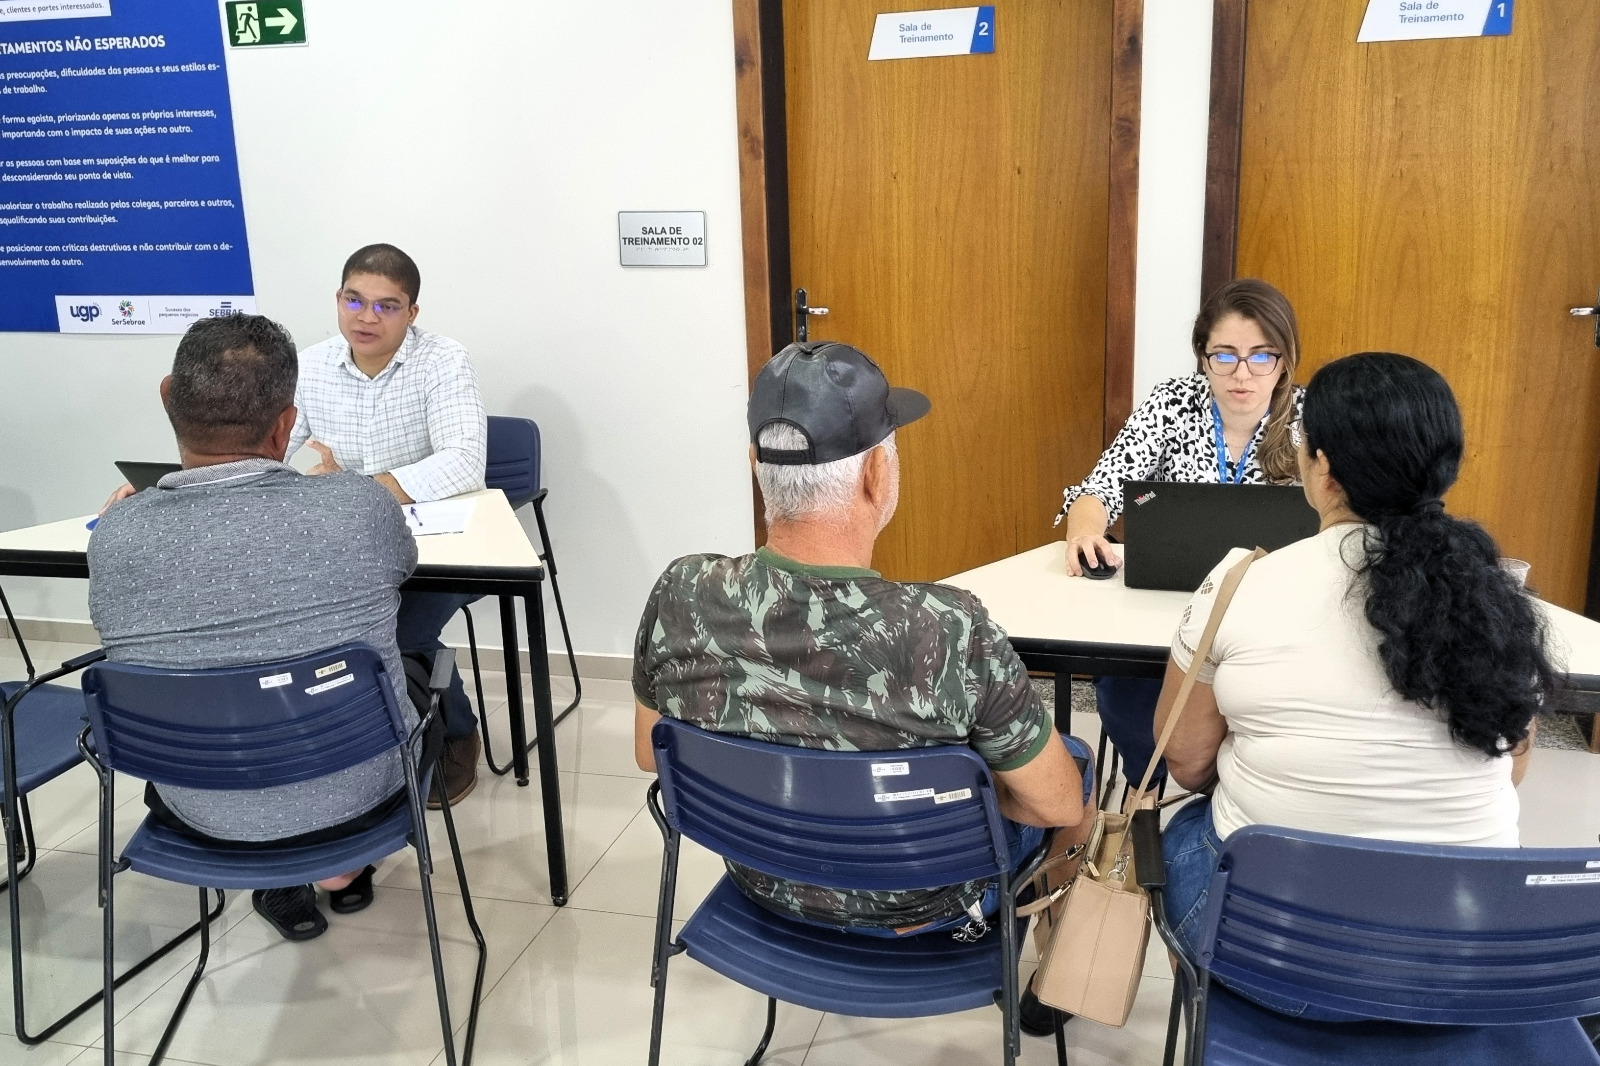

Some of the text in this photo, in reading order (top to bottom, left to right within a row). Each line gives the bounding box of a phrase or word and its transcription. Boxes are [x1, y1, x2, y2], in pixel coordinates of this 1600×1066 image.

[6, 6, 31, 14] clientes
[38, 5, 59, 13] partes
[60, 2, 105, 11] interessadas.
[1399, 0, 1439, 11] Sala de
[1497, 2, 1505, 18] 1
[1399, 13, 1464, 23] Treinamento
[899, 22, 932, 32] Sala de
[979, 21, 989, 36] 2
[65, 36, 91, 51] NÃO
[95, 35, 166, 50] ESPERADOS
[899, 33, 954, 43] Treinamento
[7, 69, 59, 81] preocupações,
[61, 67, 106, 77] dificuldades
[108, 66, 121, 75] das
[123, 66, 154, 76] pessoas
[162, 65, 179, 73] seus
[181, 62, 206, 72] estilos
[207, 63, 220, 71] es-
[3, 84, 48, 94] de trabalho.
[2, 115, 25, 124] forma
[57, 112, 101, 123] priorizando
[102, 113, 130, 122] apenas
[142, 109, 174, 121] próprios
[175, 109, 217, 119] interesses,
[2, 129, 45, 139] importando
[71, 127, 102, 138] impacto
[104, 127, 113, 135] de
[134, 126, 156, 136] ações
[169, 125, 193, 133] outro.
[16, 160, 45, 168] pessoas
[63, 157, 81, 166] base
[96, 156, 137, 167] suposições
[138, 155, 148, 164] do
[149, 157, 164, 165] que
[165, 154, 170, 163] é
[172, 154, 200, 163] melhor
[201, 155, 220, 164] para
[2, 172, 63, 182] desconsiderando
[79, 172, 101, 182] ponto
[102, 171, 112, 179] de
[113, 171, 134, 179] vista.
[41, 200, 74, 209] trabalho
[75, 200, 109, 209] realizado
[110, 199, 130, 210] pelos
[131, 199, 163, 210] colegas,
[164, 198, 199, 209] parceiros
[207, 199, 235, 208] outros,
[67, 214, 119, 225] contribuições.
[641, 226, 682, 235] SALA DE
[622, 237, 703, 246] TREINAMENTO 02
[6, 244, 43, 254] posicionar
[90, 243, 132, 252] destrutivas
[139, 243, 154, 251] não
[155, 242, 193, 251] contribuir
[220, 242, 234, 251] de-
[51, 258, 61, 266] do
[70, 305, 100, 322] ugp
